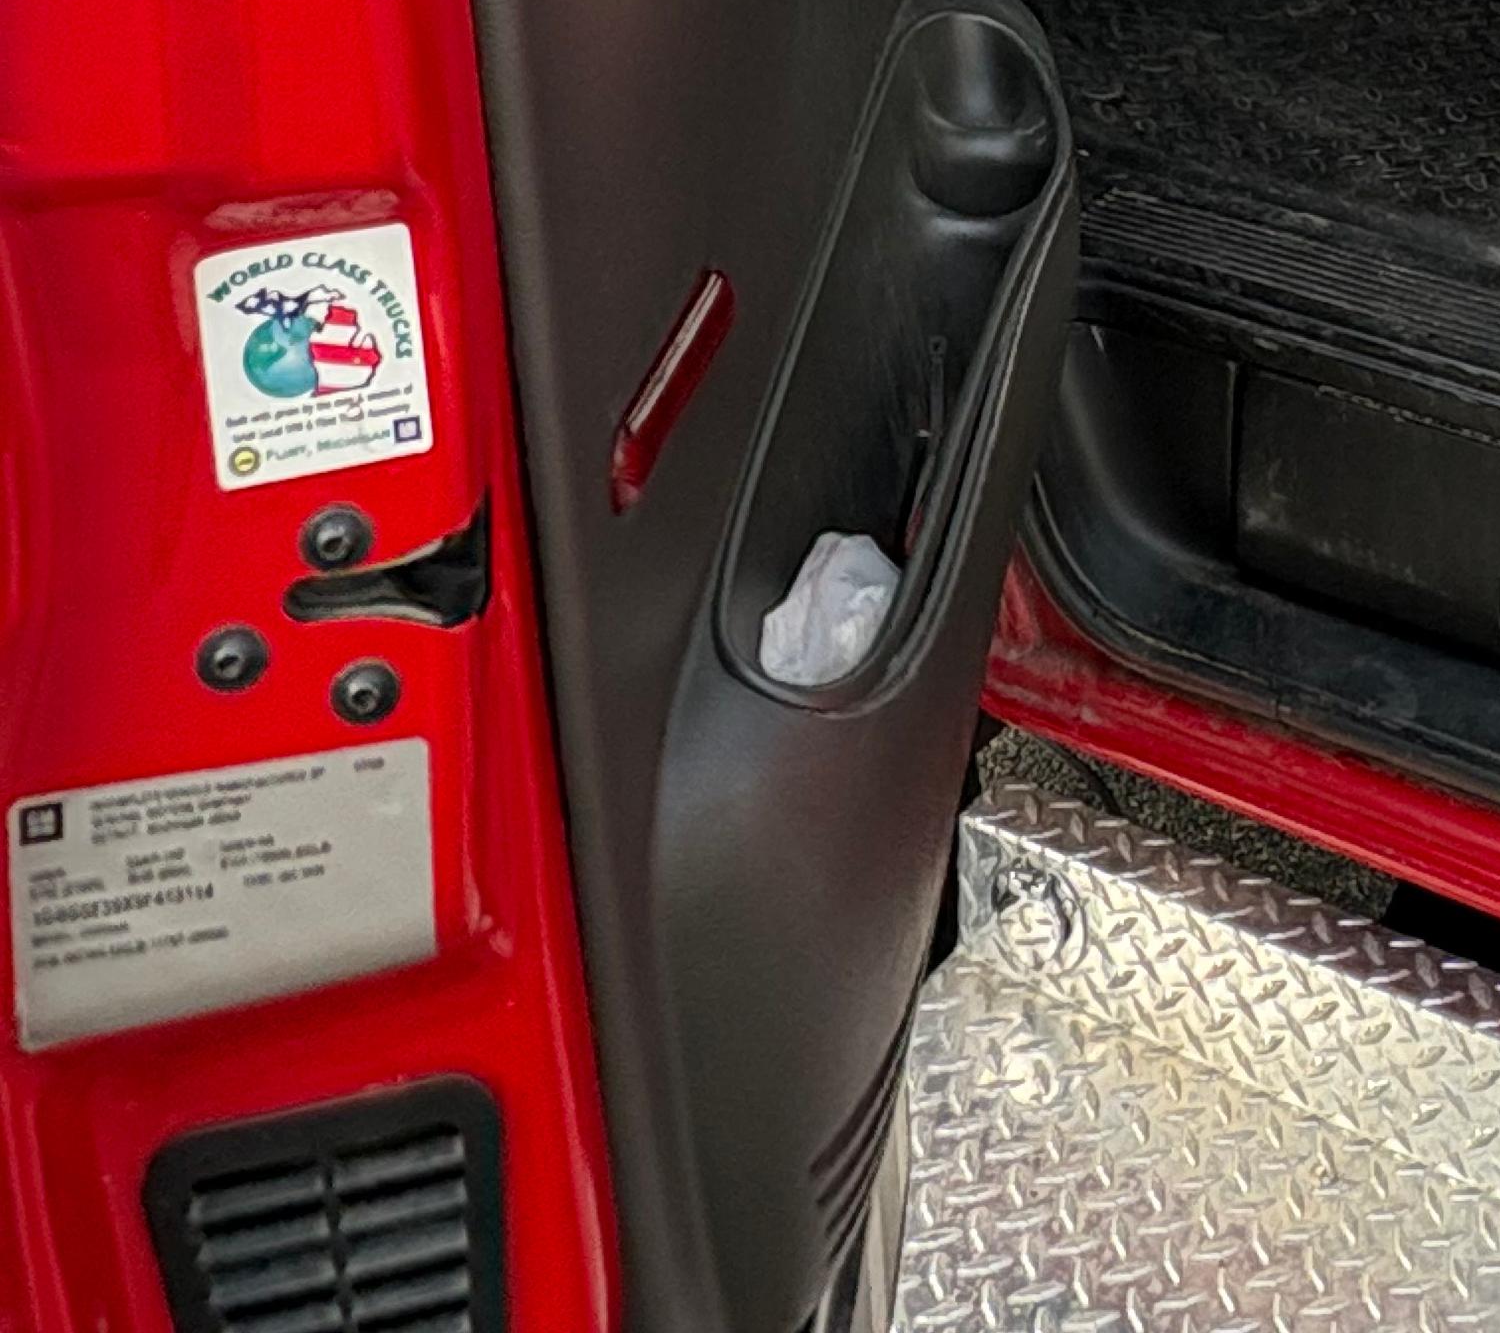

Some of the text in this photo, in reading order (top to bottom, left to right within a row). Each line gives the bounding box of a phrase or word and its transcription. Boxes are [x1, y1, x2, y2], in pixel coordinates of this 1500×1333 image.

[207, 251, 413, 359] WORLD CLASS TRUCKS
